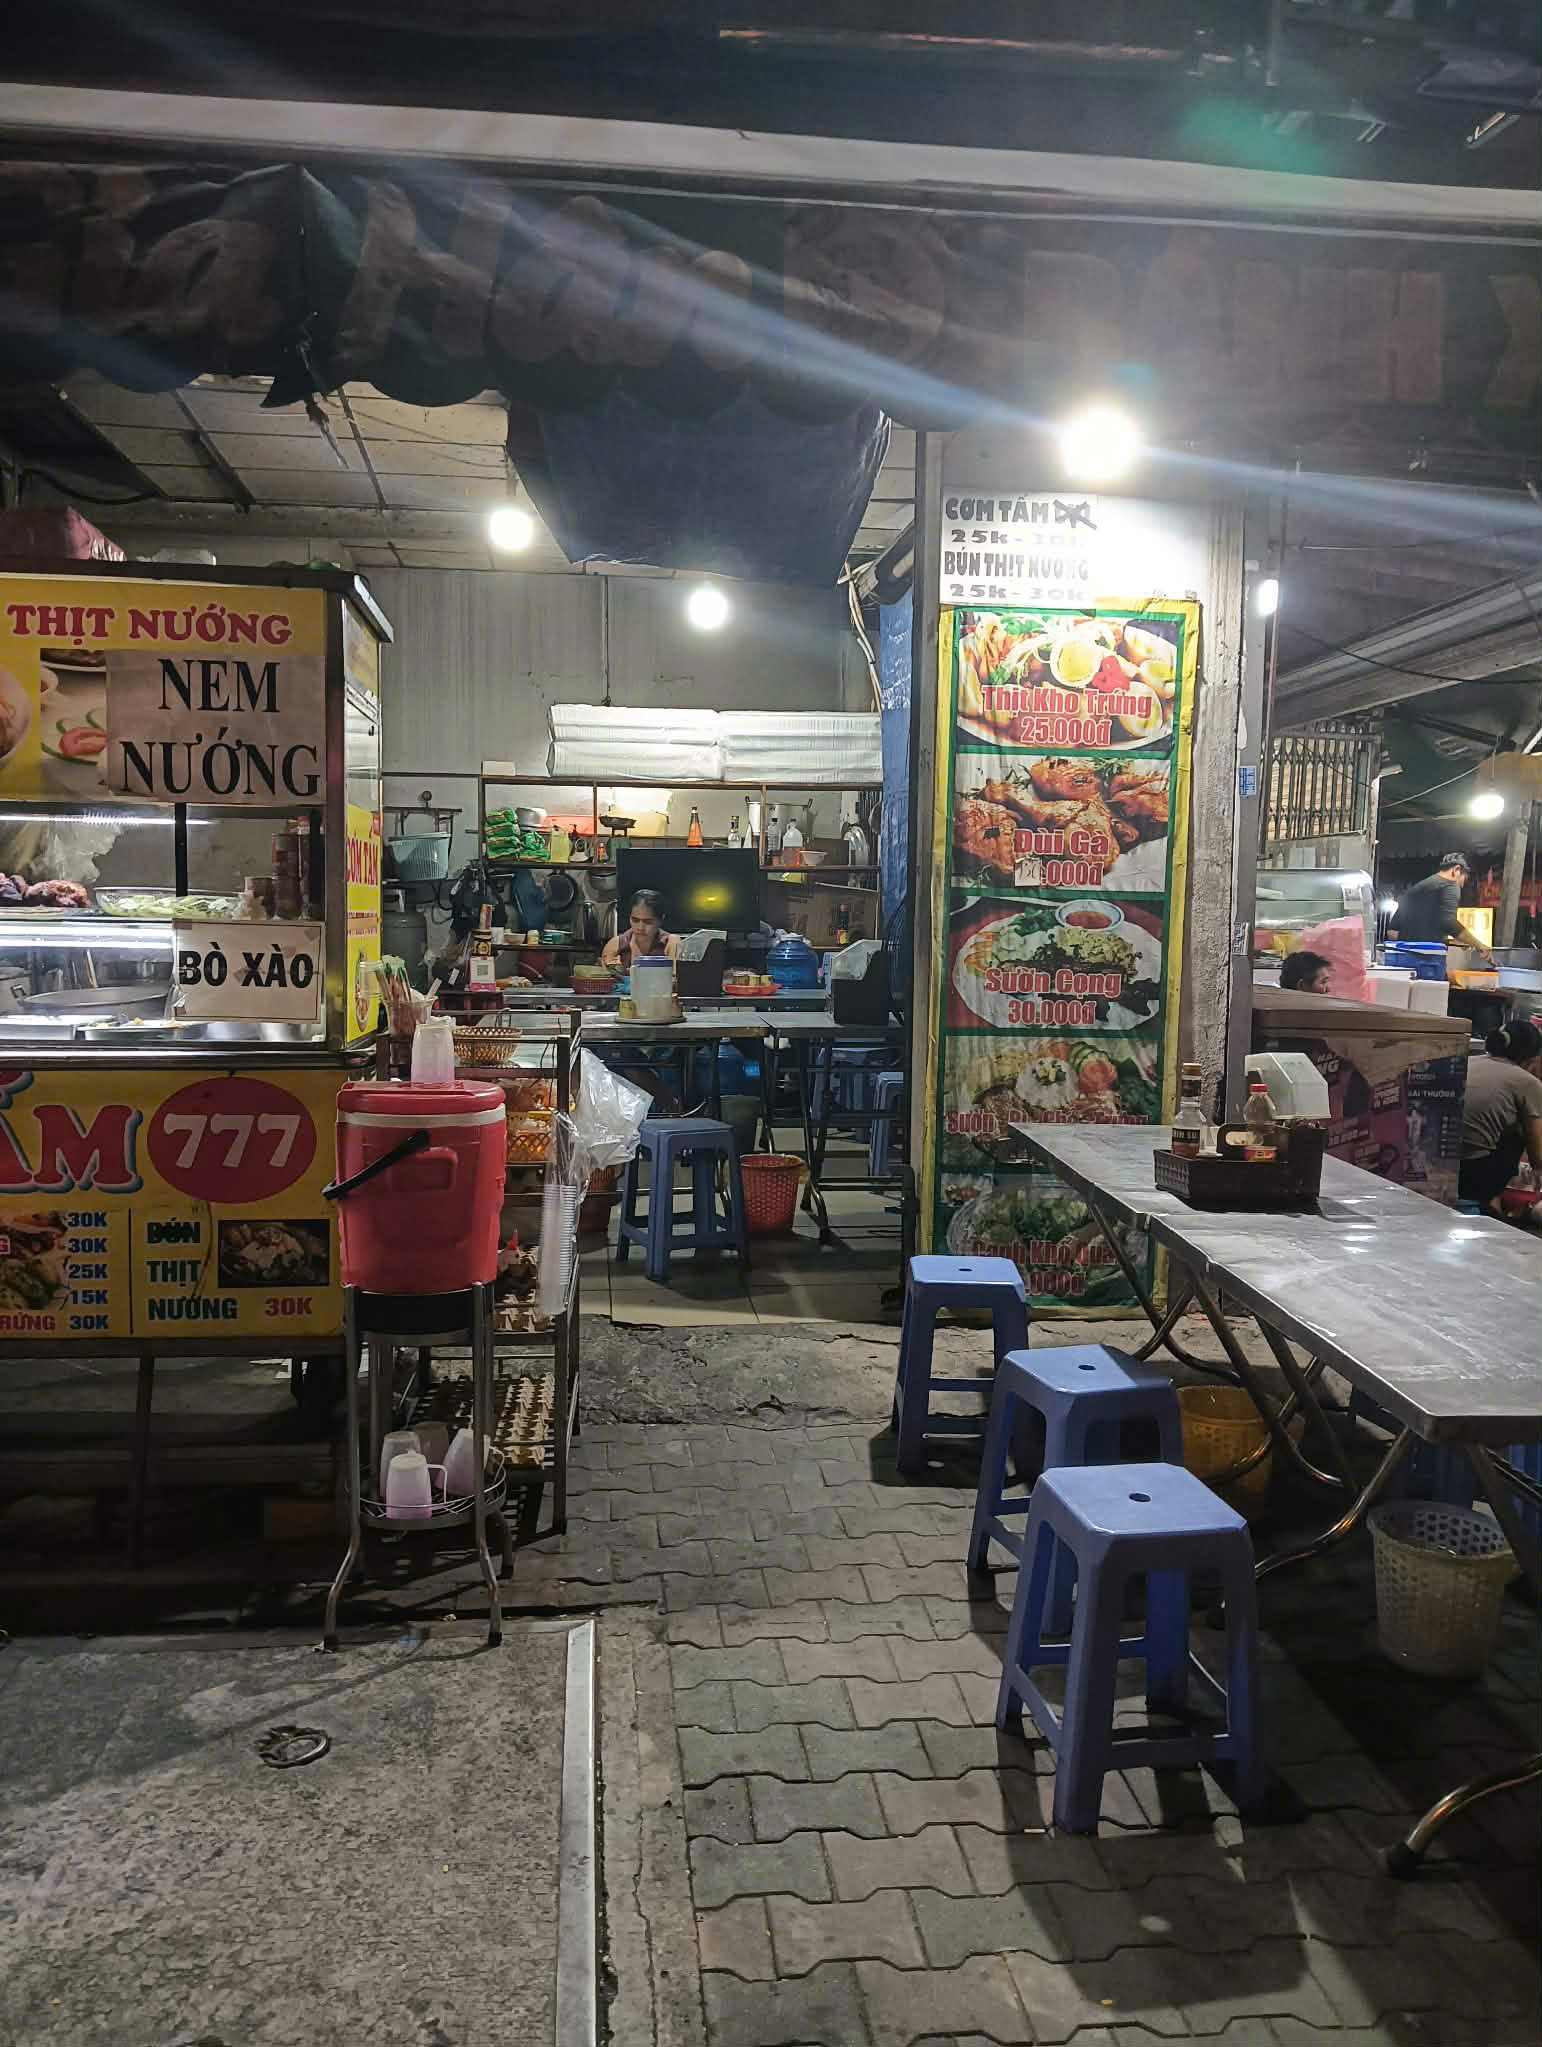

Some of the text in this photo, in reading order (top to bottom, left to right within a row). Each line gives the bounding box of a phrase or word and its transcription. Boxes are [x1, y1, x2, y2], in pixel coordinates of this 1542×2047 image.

[945, 497, 994, 522] CƠM
[999, 493, 1049, 524] TẤM
[944, 547, 980, 576] BÚN
[984, 552, 1024, 580] THỊT
[7, 602, 293, 646] THỊT NƯỚNG
[158, 658, 281, 713] NEM
[982, 685, 1152, 720] Thịt Kho Trứng
[1020, 717, 1112, 745] 25.000đ
[120, 726, 321, 797] NƯỚNG
[1013, 828, 1109, 856] Đùi Gà
[179, 942, 314, 989] BÒ XÀO
[985, 966, 1121, 999] Sườn Cọng
[1008, 1000, 1096, 1025] 30.000đ
[163, 1113, 301, 1169] 777
[67, 1211, 108, 1229] 30K
[68, 1237, 108, 1254] 30K
[69, 1263, 108, 1279] 25K
[146, 1259, 201, 1287] THỊT
[71, 1288, 108, 1304] 15K
[148, 1294, 313, 1321] NƯỚNG 30K
[0, 1311, 109, 1330] RỨNG 30K
